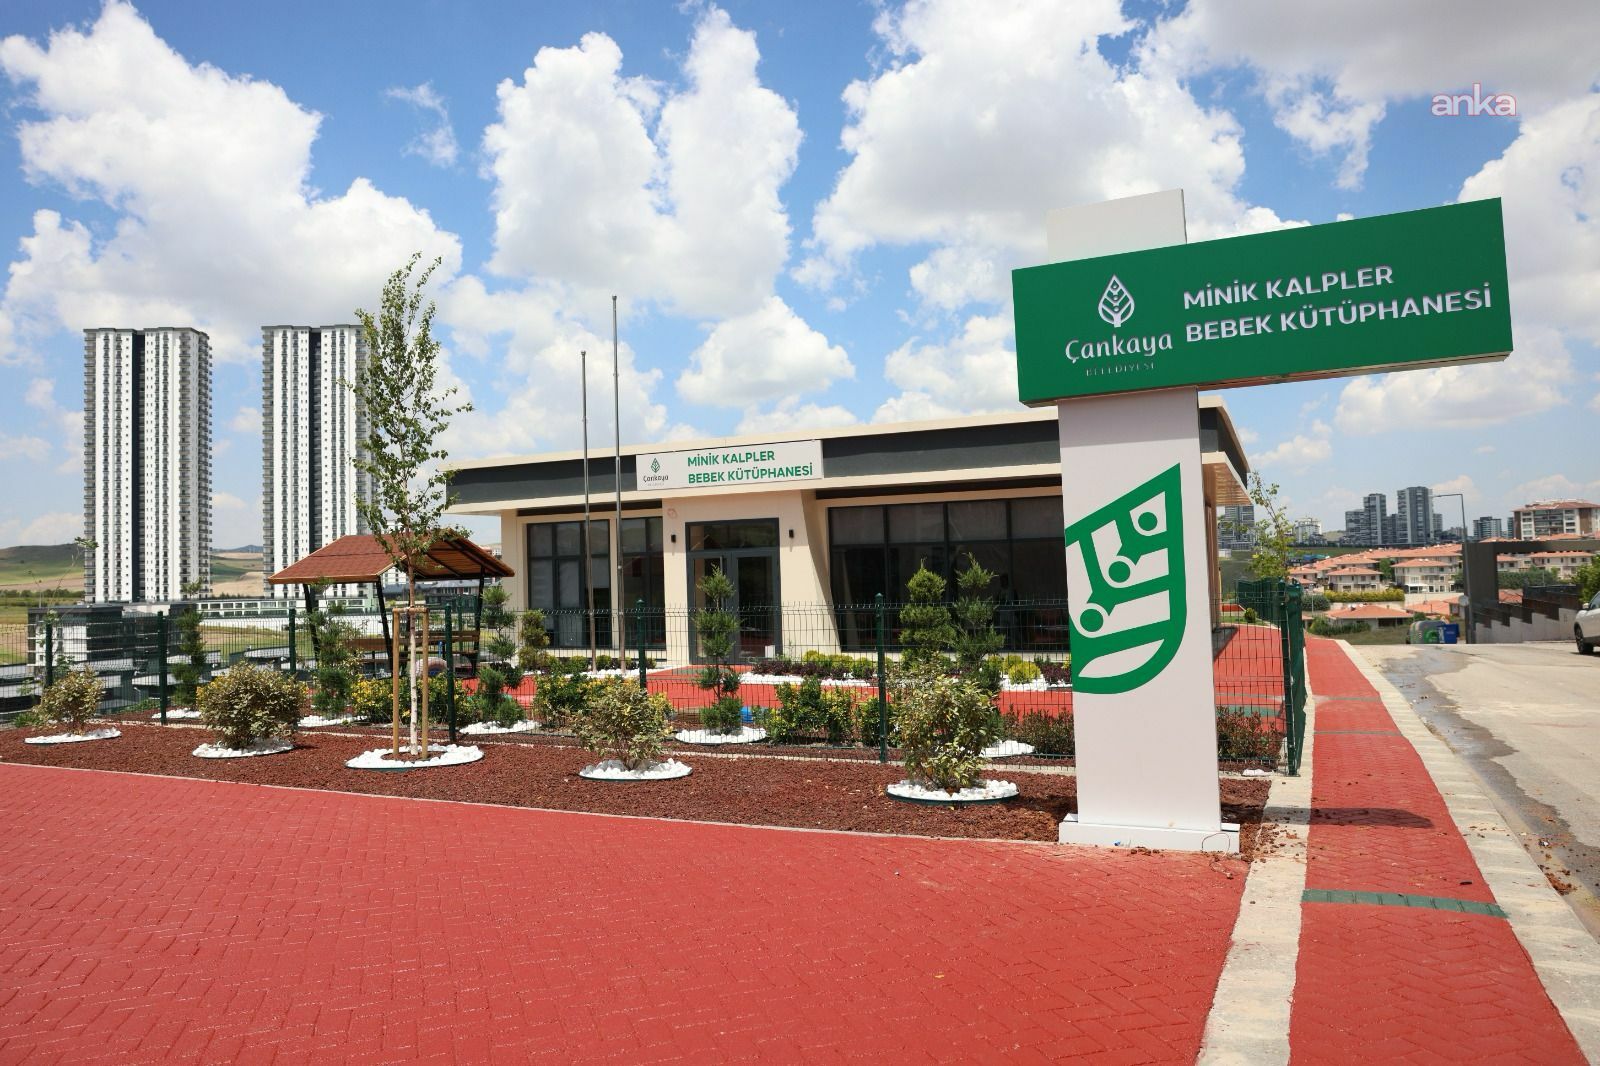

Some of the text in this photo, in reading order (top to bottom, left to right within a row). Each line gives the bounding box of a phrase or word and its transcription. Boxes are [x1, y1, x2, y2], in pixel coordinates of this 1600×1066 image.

[1183, 265, 1394, 310] MİNİK KALPLER
[1186, 282, 1492, 342] BEBEK KÜTÜPHANESİ
[1065, 333, 1173, 364] Çankaya
[687, 450, 775, 467] MİNİK KALPLER
[688, 462, 813, 484] BEBEK KÜTÜPHANESİ
